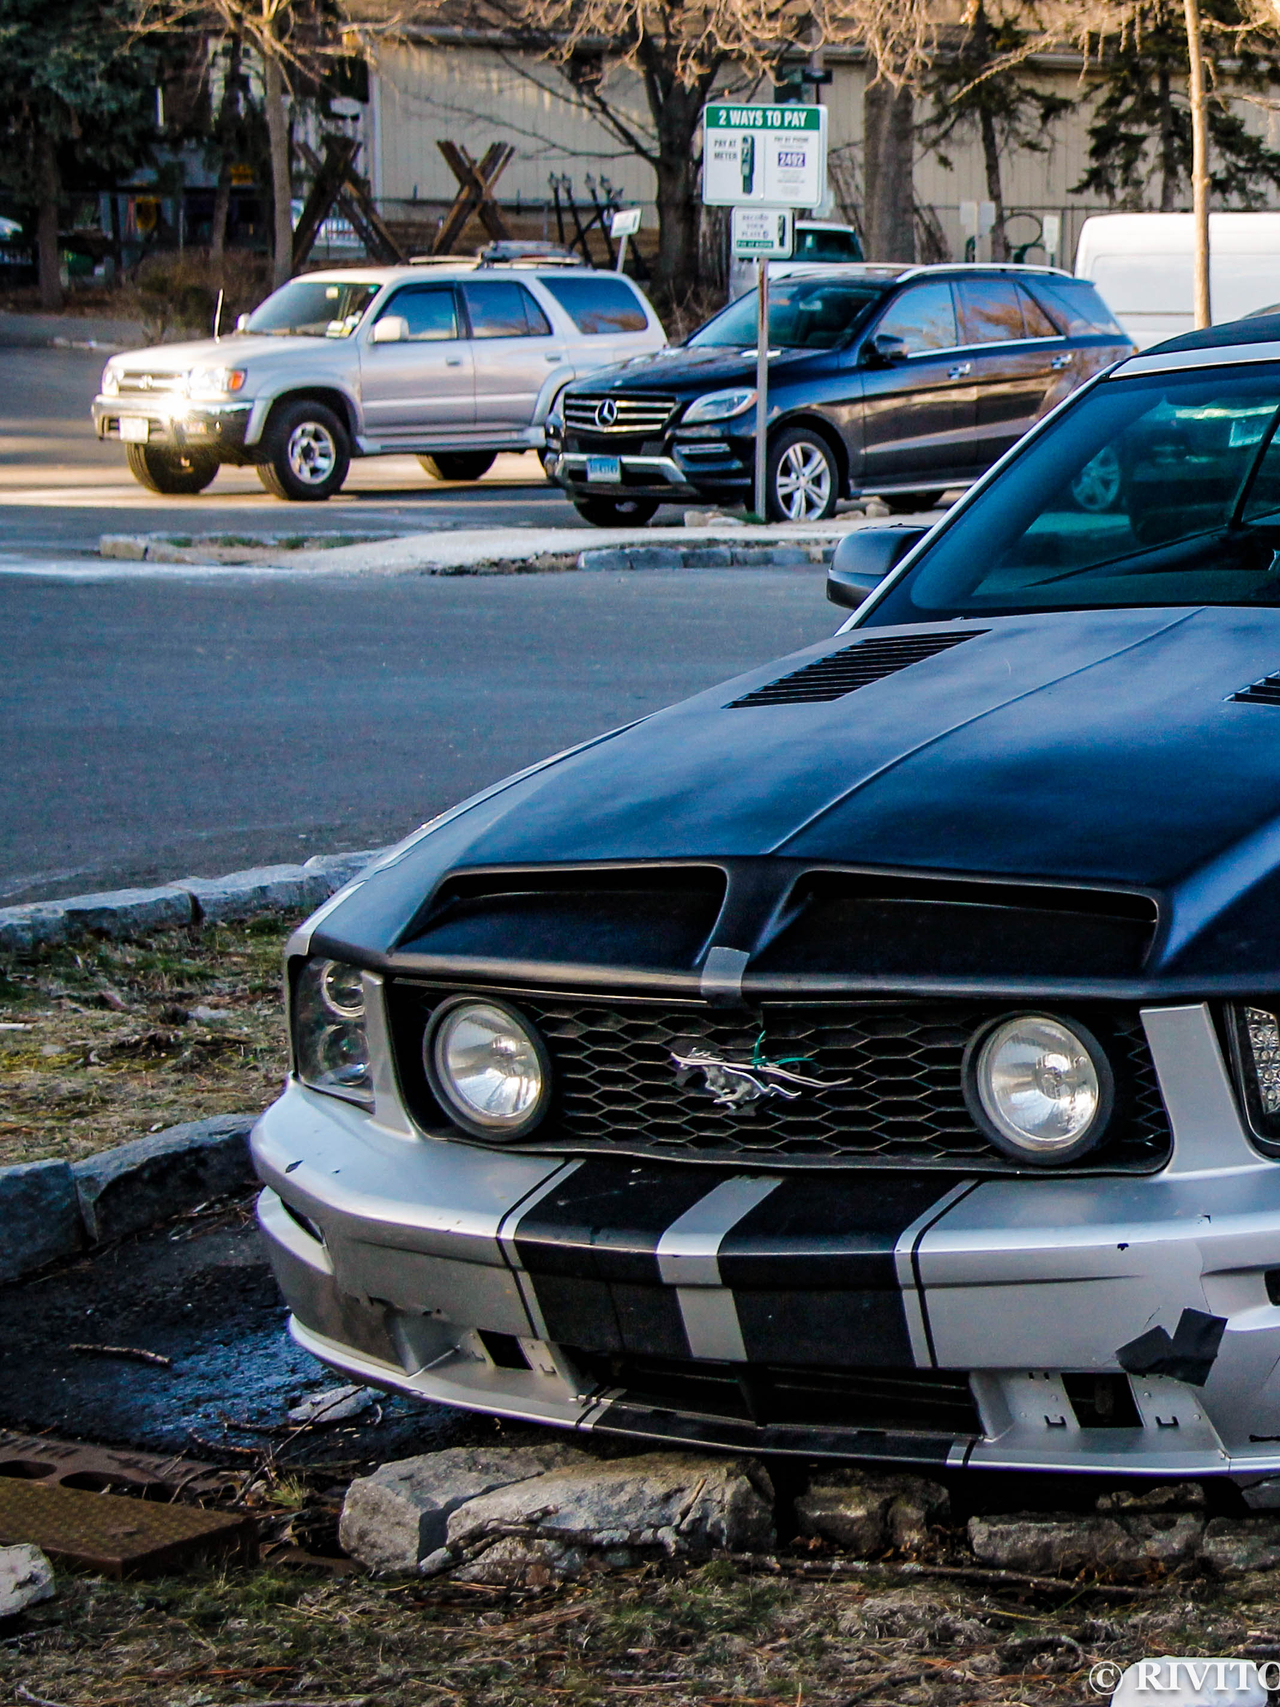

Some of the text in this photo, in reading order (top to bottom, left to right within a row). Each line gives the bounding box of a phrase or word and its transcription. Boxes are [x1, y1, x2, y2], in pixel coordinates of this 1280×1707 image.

[718, 109, 807, 128] 2 WAYS TO PAY
[714, 138, 737, 149] PAY AT
[713, 151, 737, 161] METER
